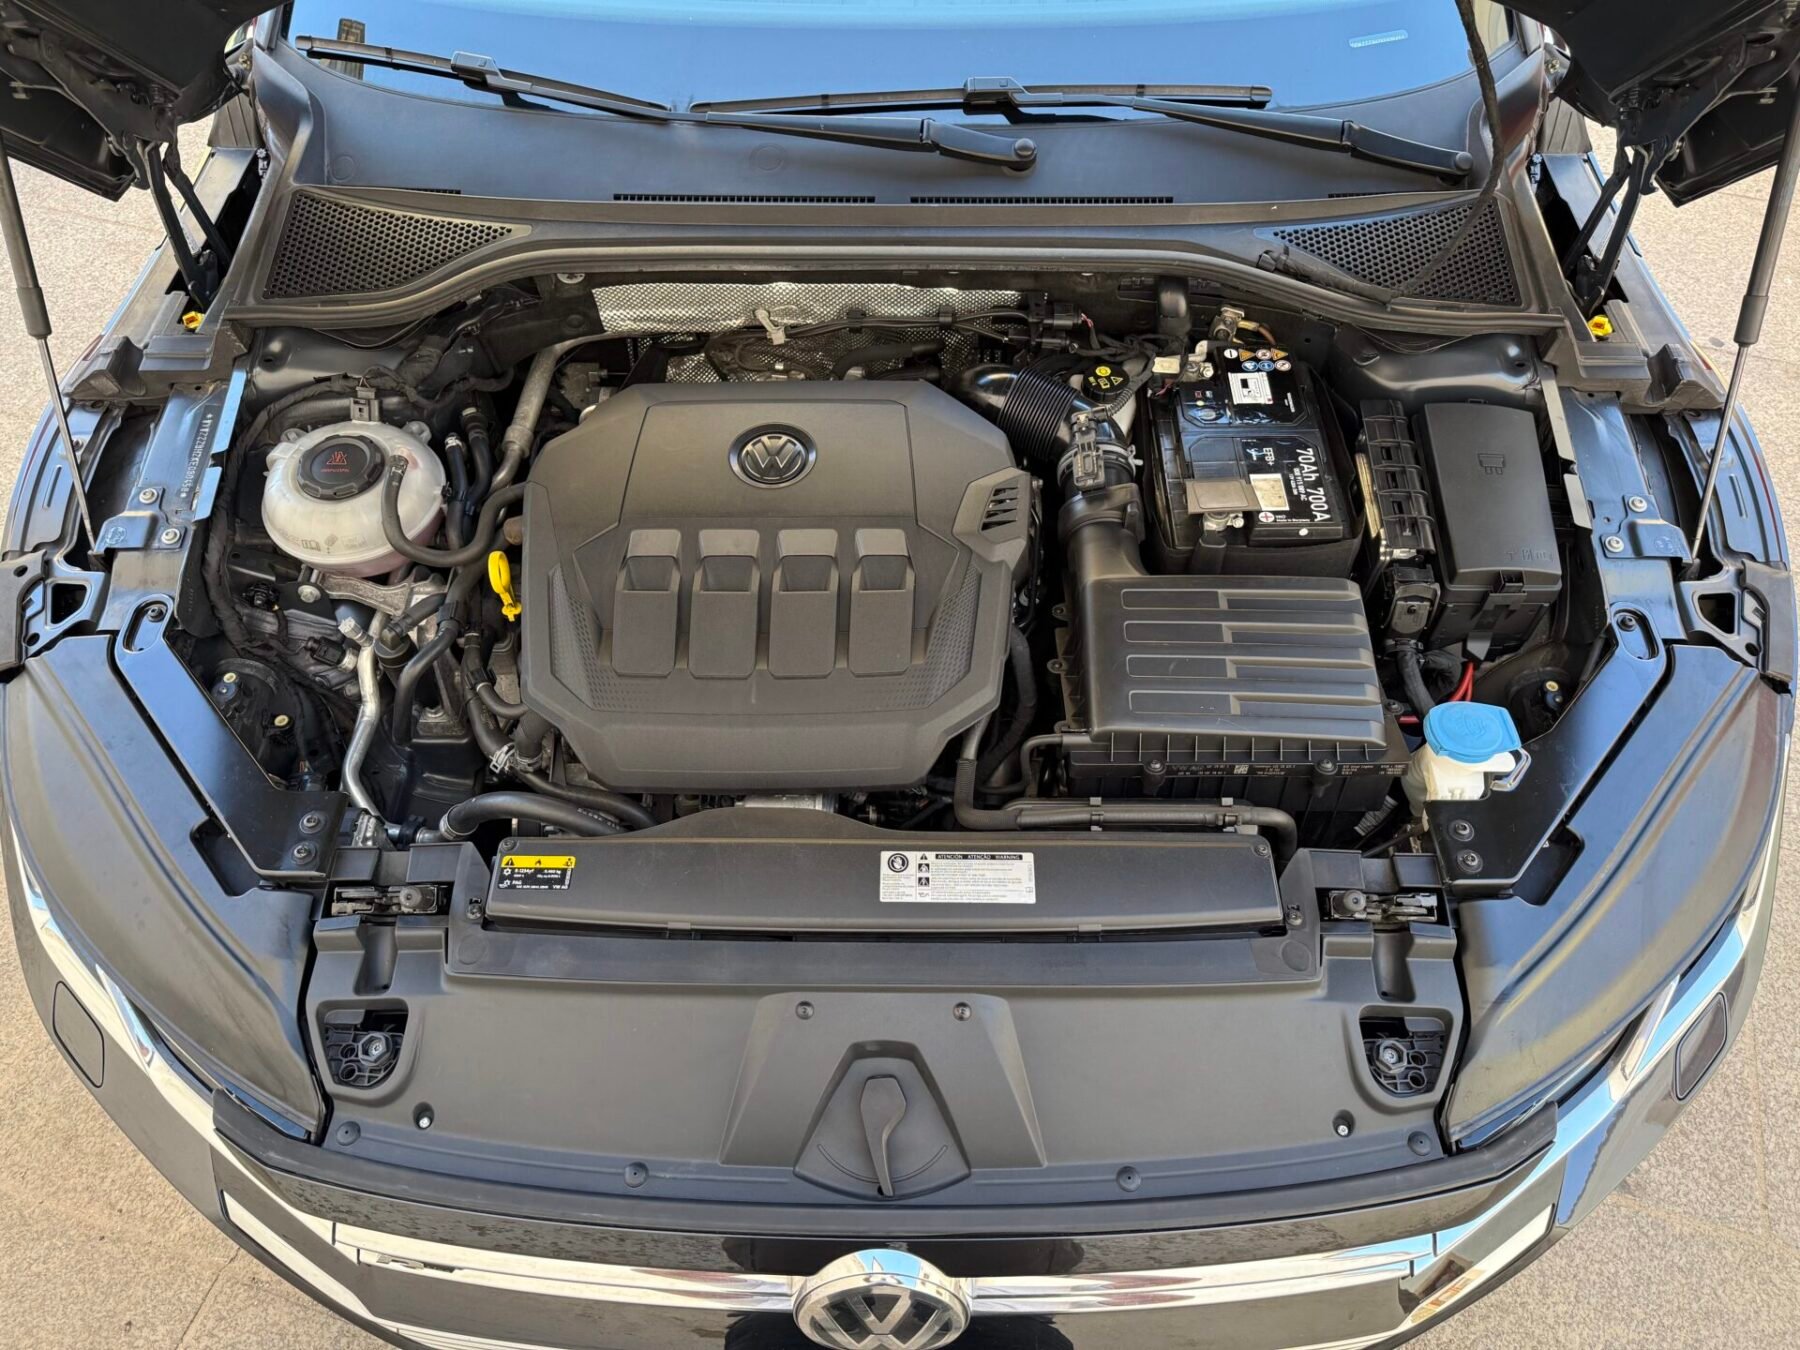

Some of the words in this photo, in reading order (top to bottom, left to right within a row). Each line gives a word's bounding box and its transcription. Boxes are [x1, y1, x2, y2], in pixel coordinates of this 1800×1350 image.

[740, 433, 806, 483] VW
[1263, 447, 1275, 466] EFB+
[1296, 447, 1319, 481] 70Ah
[1306, 487, 1331, 522] 700A
